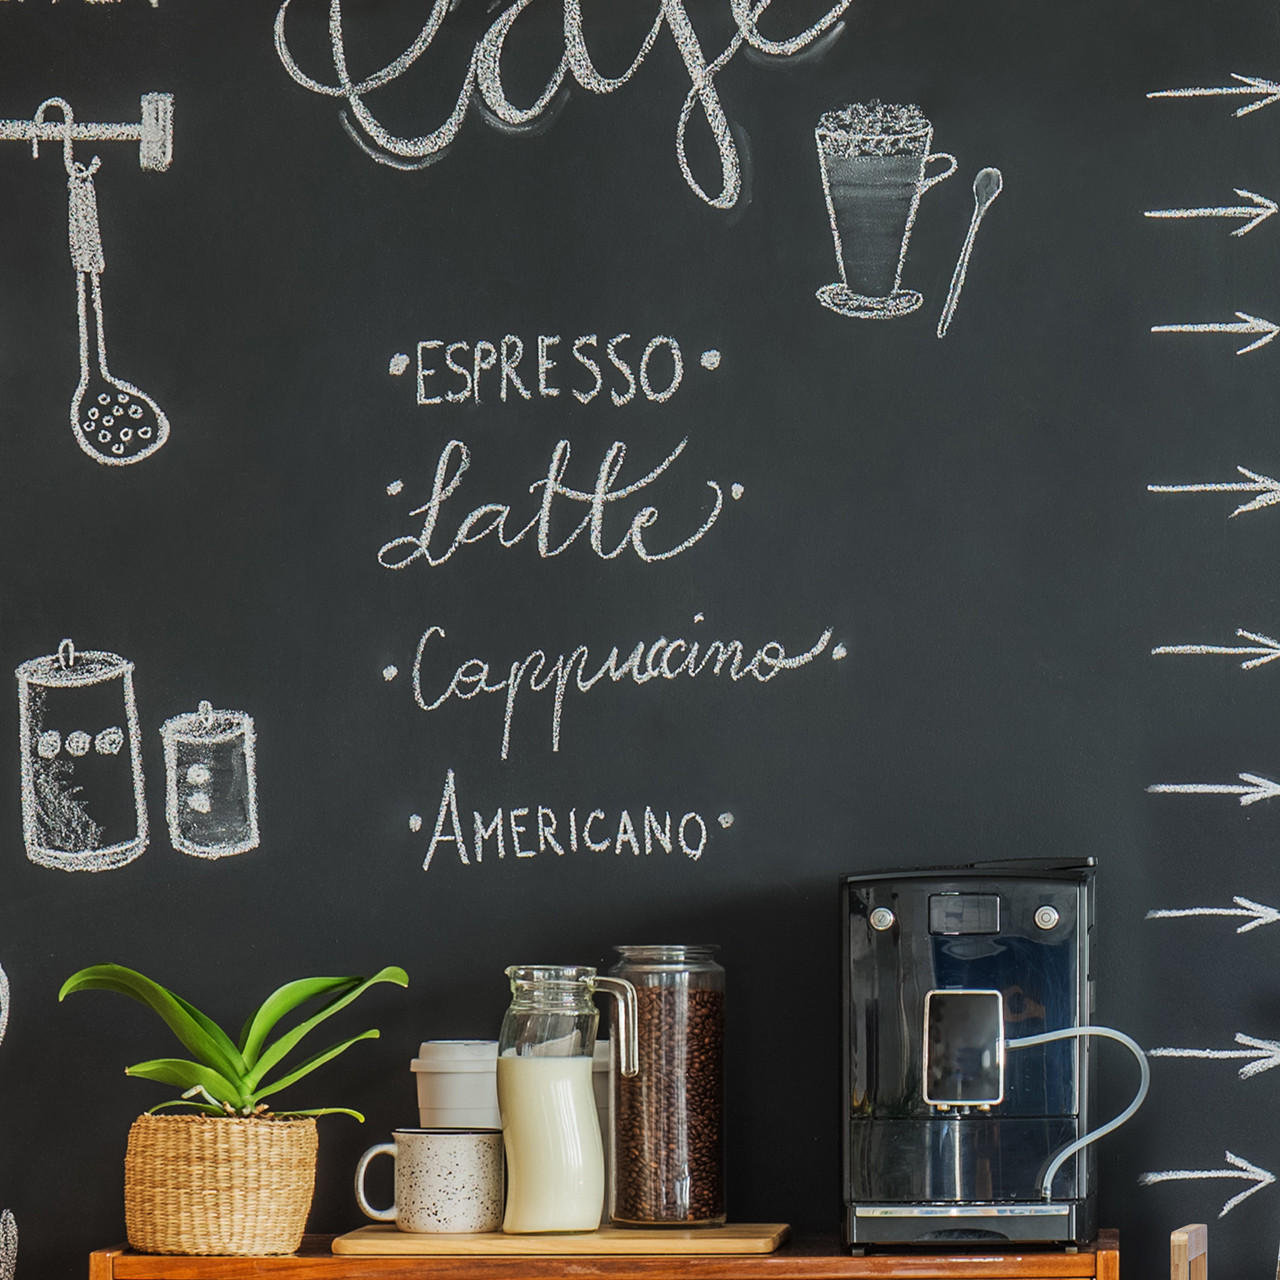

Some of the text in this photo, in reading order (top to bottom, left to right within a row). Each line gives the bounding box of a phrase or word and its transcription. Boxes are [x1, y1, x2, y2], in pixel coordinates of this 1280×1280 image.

[416, 333, 685, 407] ESPRESSO
[377, 436, 724, 569] Latte
[411, 612, 835, 760] Cappuccino
[423, 768, 708, 872] AMERICANO
